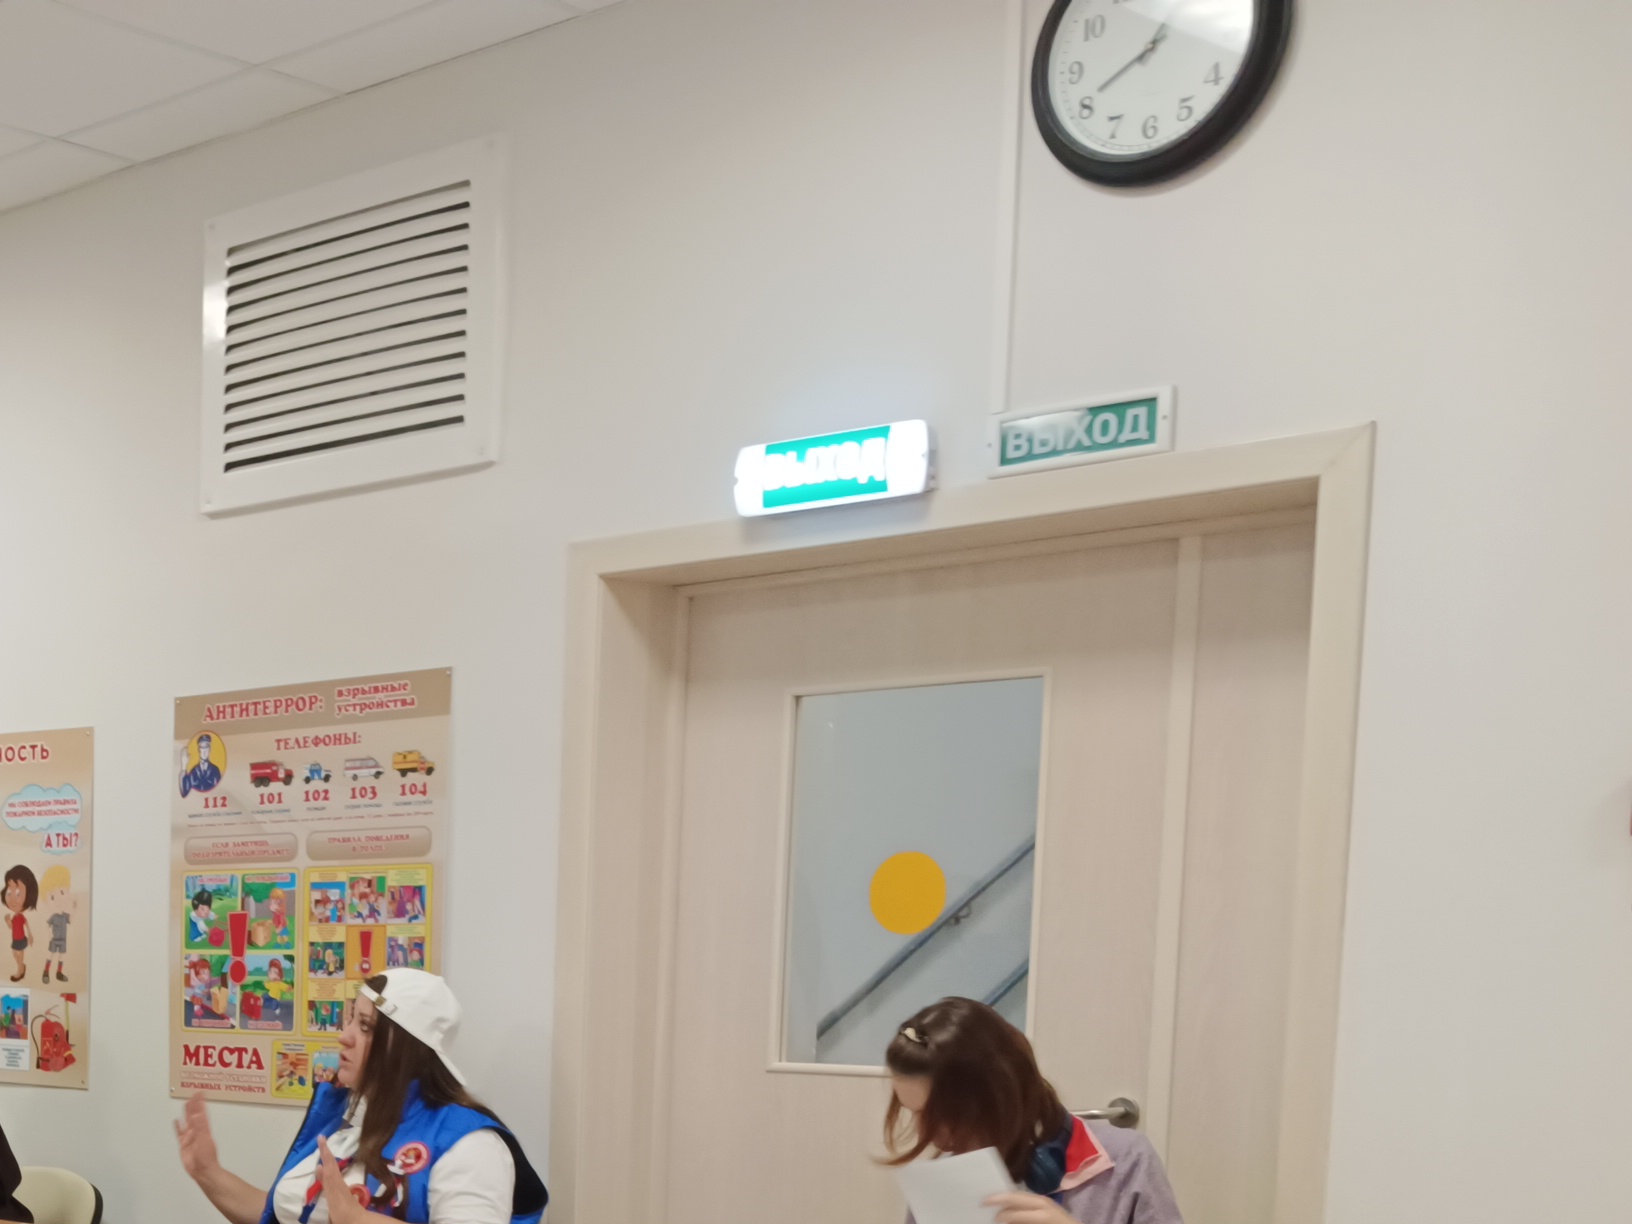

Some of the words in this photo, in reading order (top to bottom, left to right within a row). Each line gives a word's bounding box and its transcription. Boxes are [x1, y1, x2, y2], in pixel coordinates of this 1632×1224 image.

[1083, 14, 1105, 42] 10
[1069, 61, 1084, 85] 9
[1203, 62, 1225, 86] 4
[1078, 96, 1095, 120] 8
[1176, 95, 1196, 122] 5
[1107, 114, 1124, 139] 7
[1141, 115, 1159, 140] 6
[1005, 406, 1150, 459] ВЫХОД
[203, 695, 325, 722] АНТИТЕРРОР:
[335, 681, 410, 699] взрывные
[335, 695, 417, 716] устройства
[274, 732, 362, 751] ТЕЛЕФОНЫ:
[203, 796, 228, 809] 112
[259, 792, 283, 805] 101
[303, 788, 330, 802] 102
[349, 785, 378, 800] 103
[399, 781, 428, 797] 104
[45, 832, 53, 848] А
[55, 832, 79, 848] ТЫ?
[182, 1044, 265, 1070] МЕСТА
